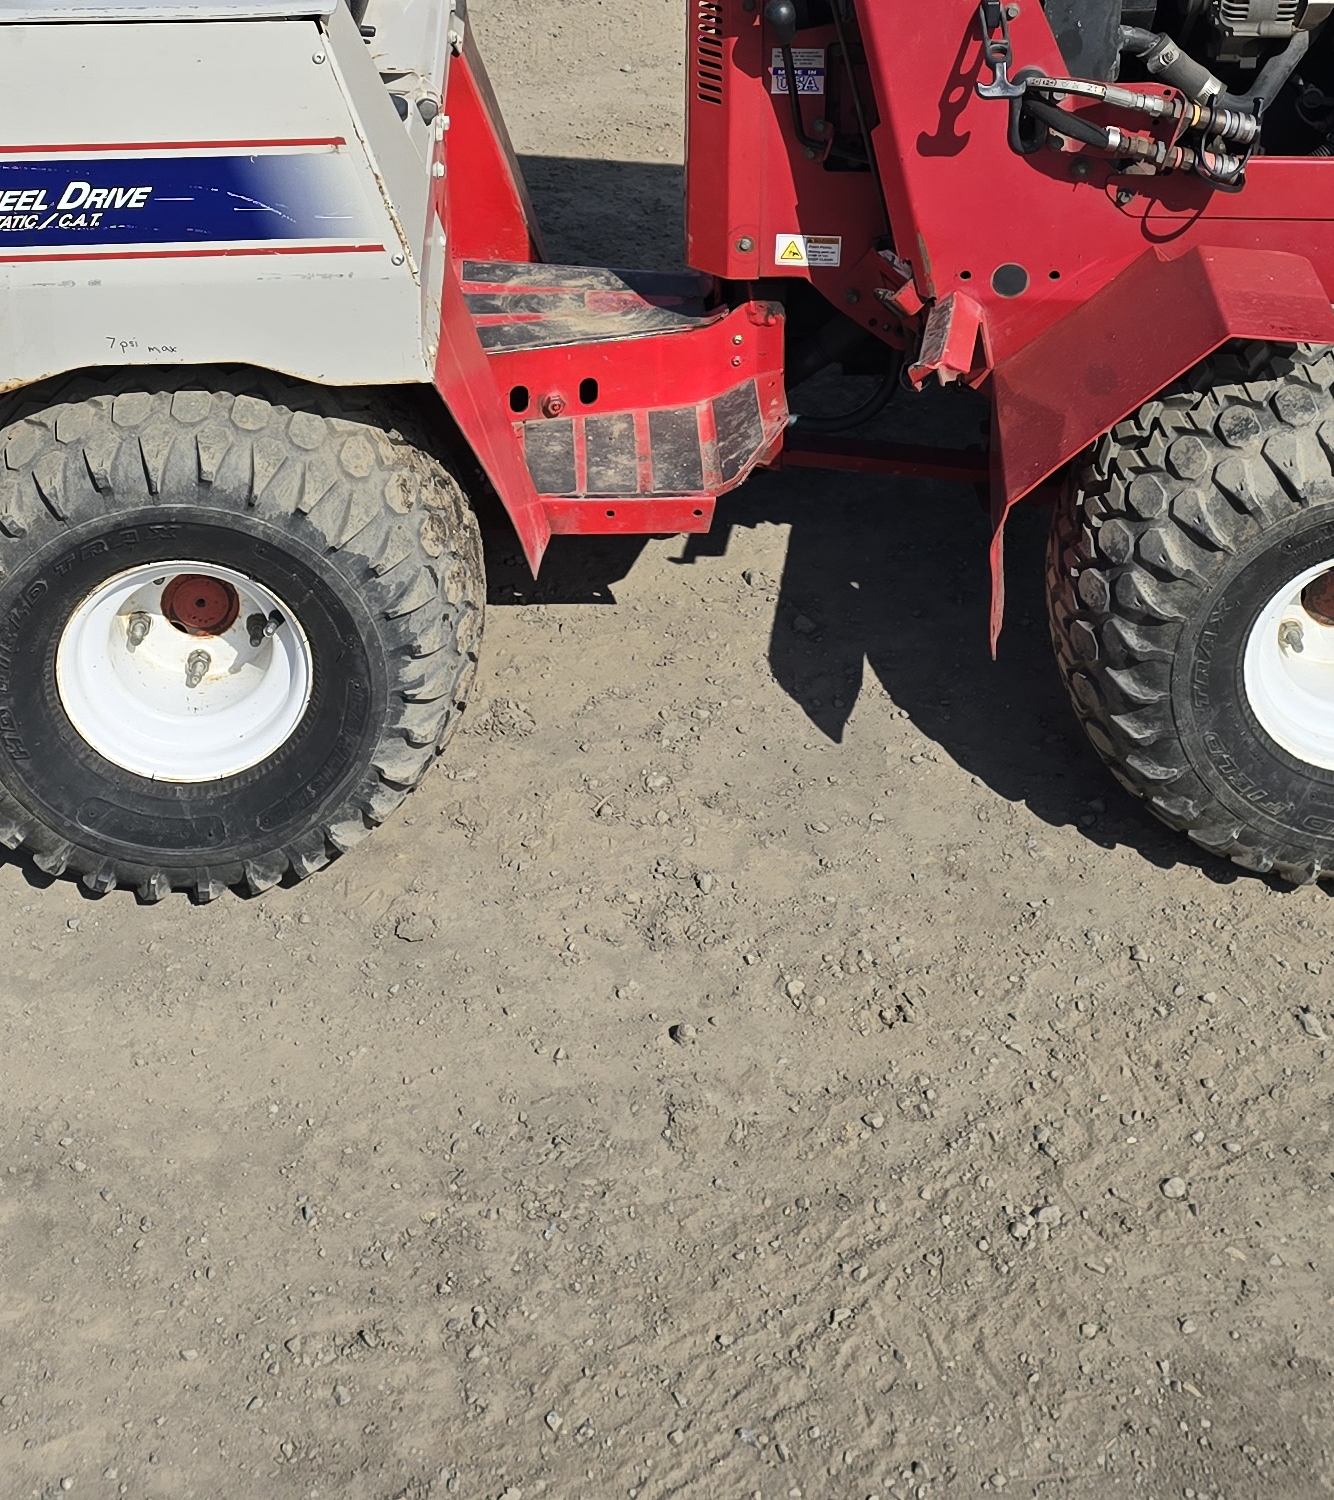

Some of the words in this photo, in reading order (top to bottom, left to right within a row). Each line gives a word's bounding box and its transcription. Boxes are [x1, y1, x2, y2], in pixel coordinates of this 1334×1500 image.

[56, 181, 153, 210] DRIVE
[147, 345, 178, 354] max
[1192, 595, 1242, 711] TRAX
[1202, 731, 1296, 816] FIELD
